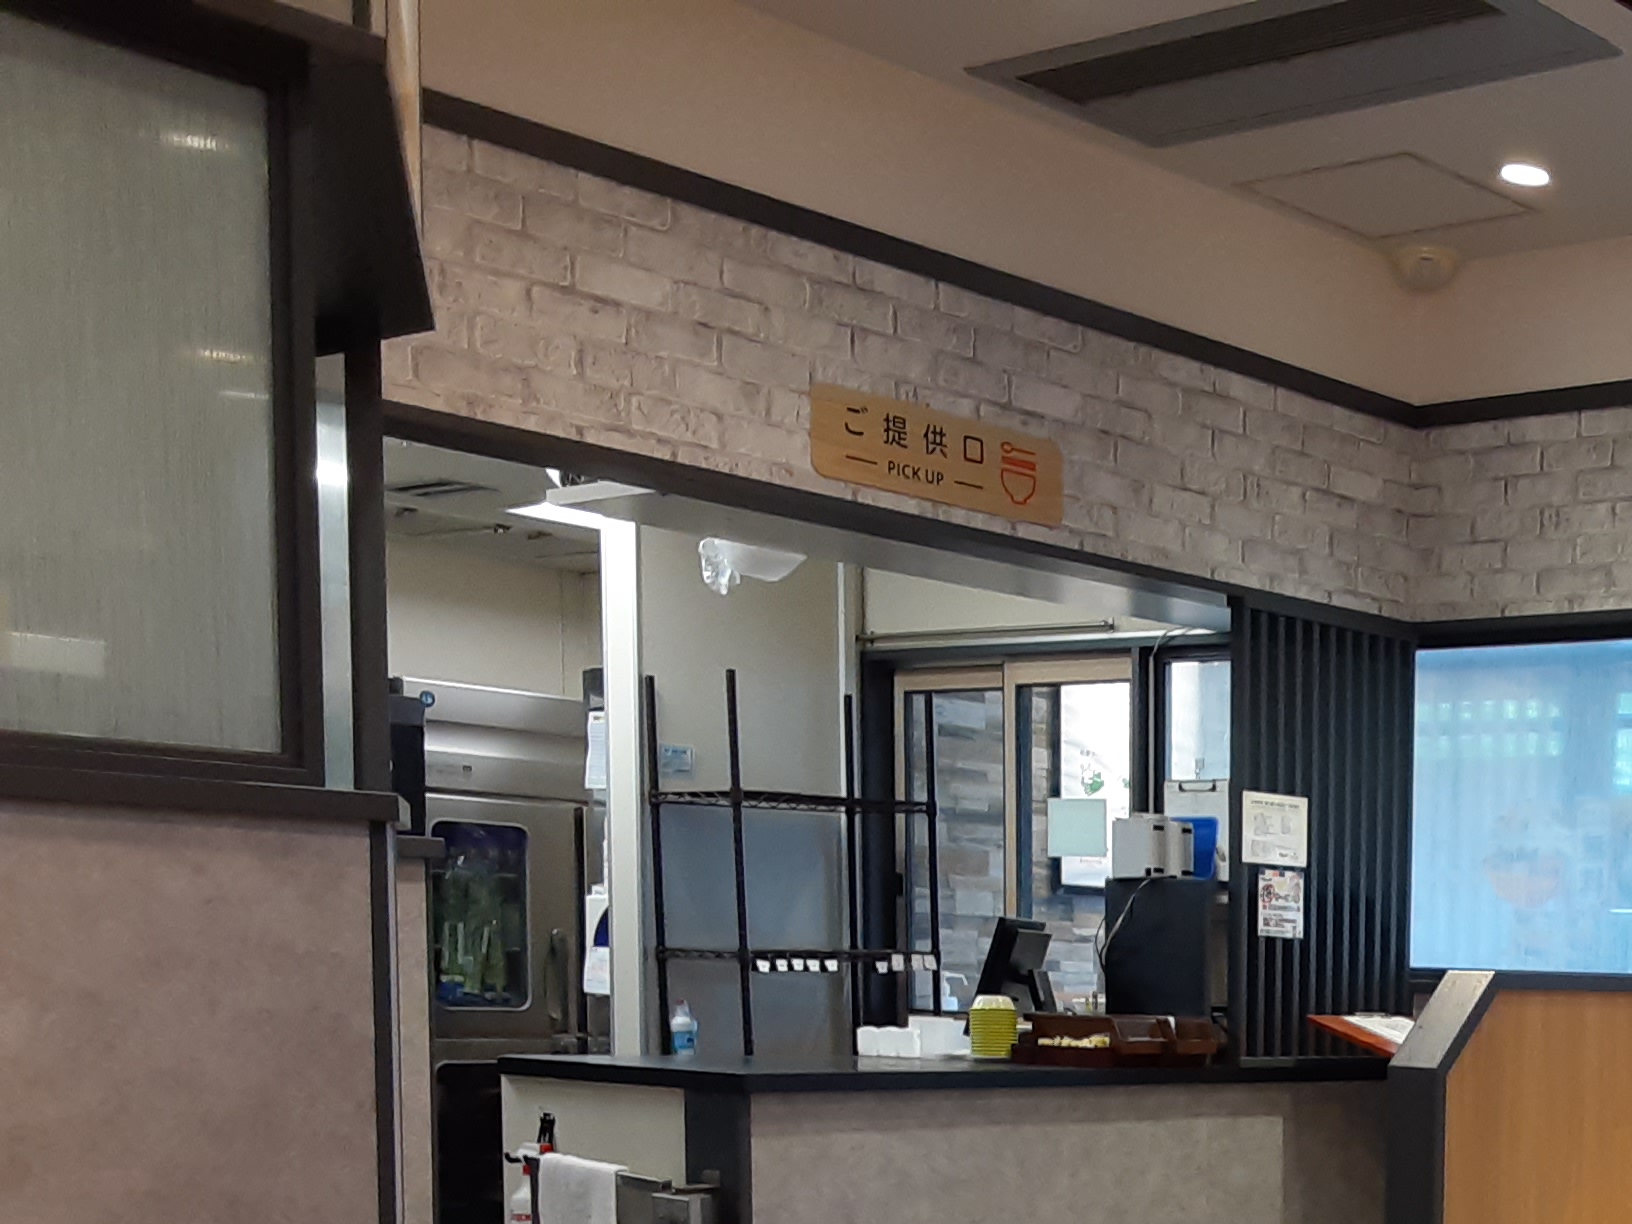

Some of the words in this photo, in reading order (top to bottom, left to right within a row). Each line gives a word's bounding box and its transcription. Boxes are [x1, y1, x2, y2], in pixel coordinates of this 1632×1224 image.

[845, 406, 984, 464] ご提供口
[888, 460, 922, 481] PICK
[925, 471, 944, 486] UP
